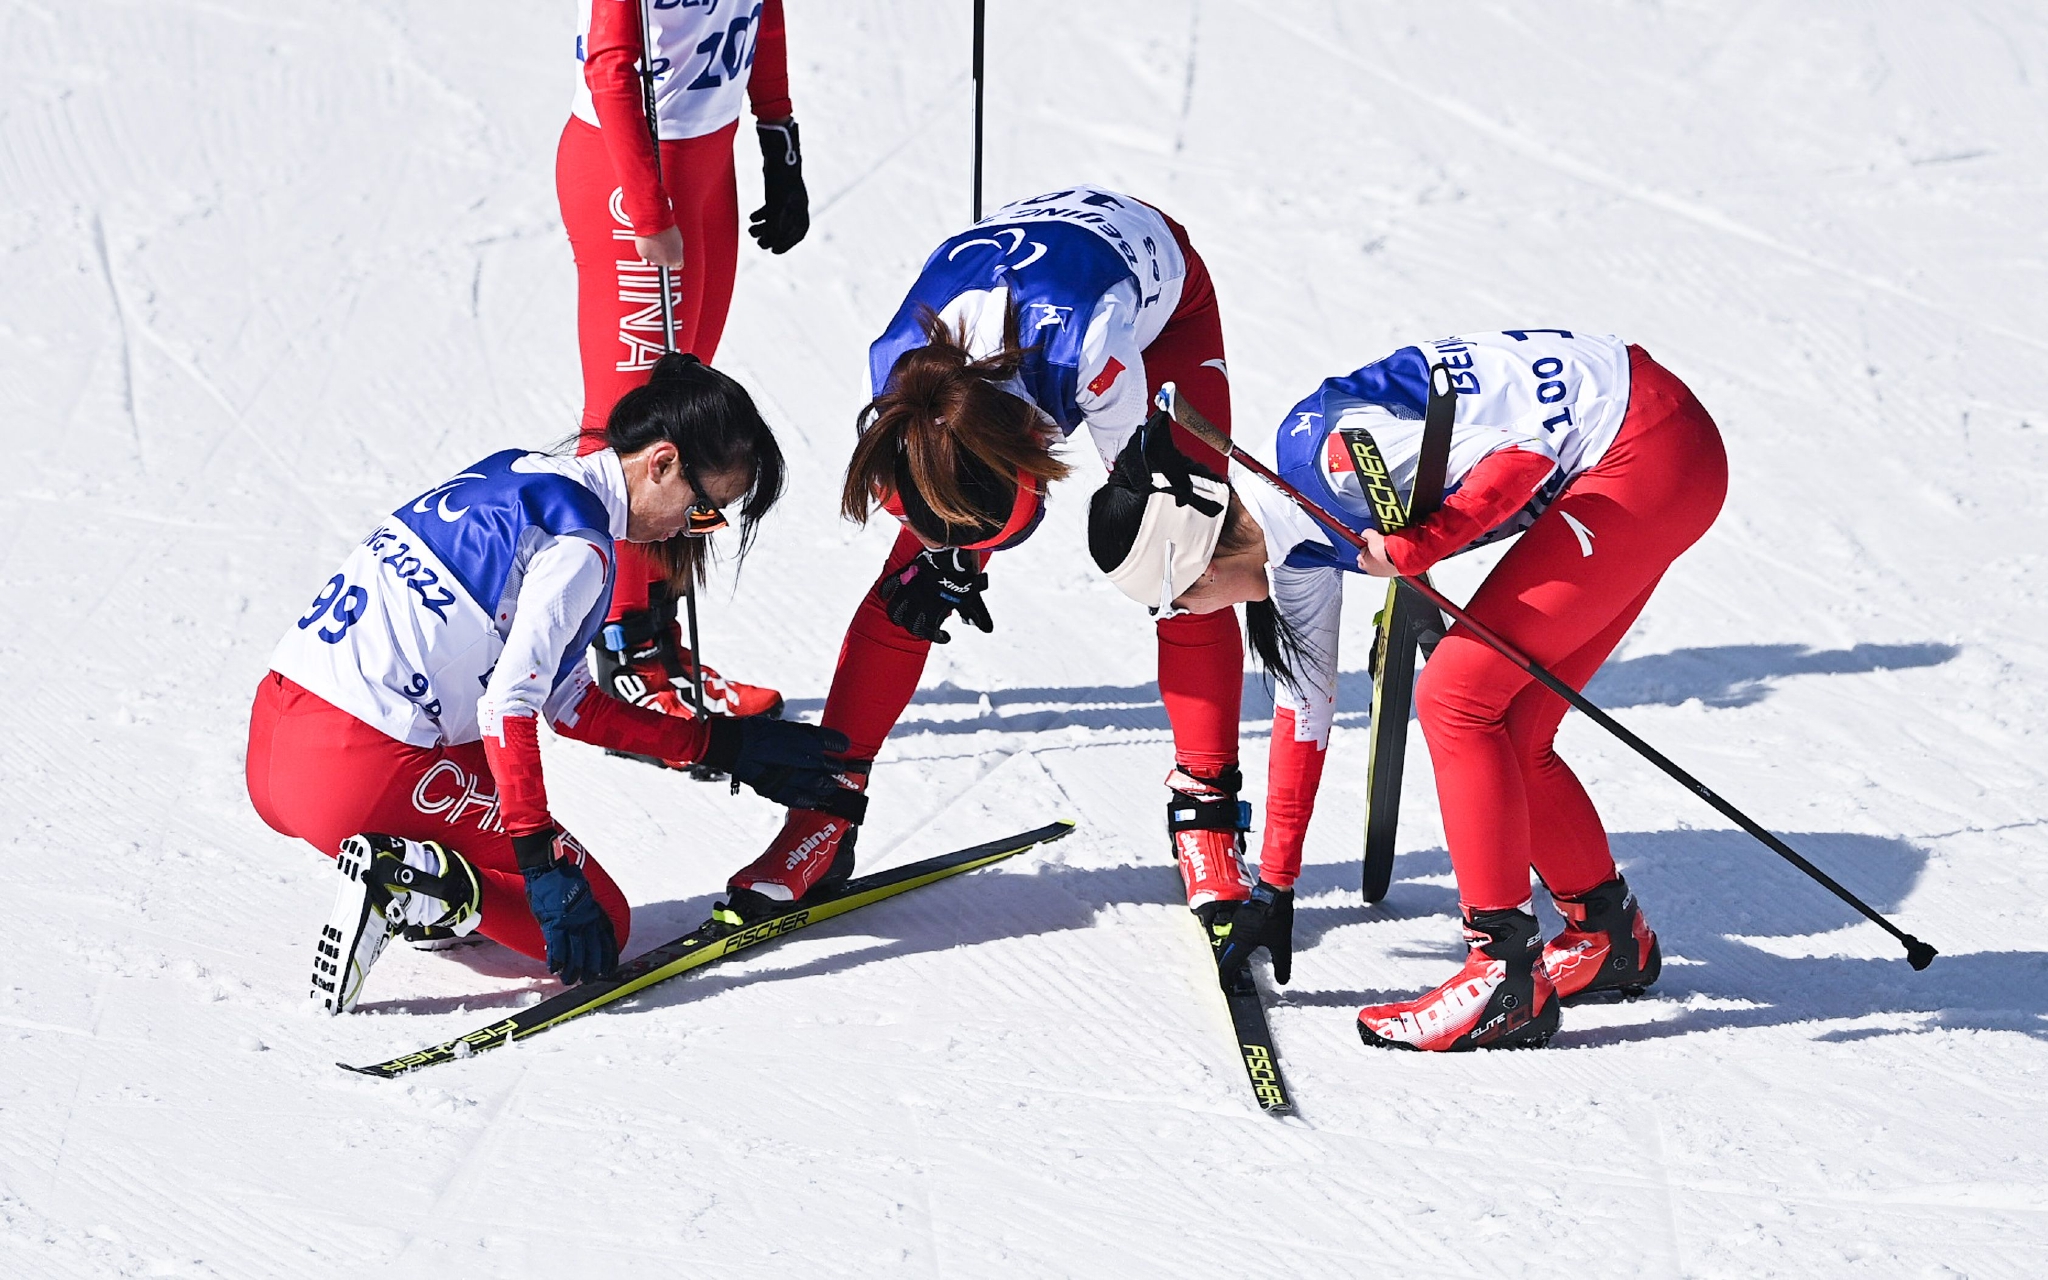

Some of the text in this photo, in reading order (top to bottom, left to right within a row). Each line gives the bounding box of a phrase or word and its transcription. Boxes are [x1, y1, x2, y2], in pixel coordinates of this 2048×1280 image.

[1010, 207, 1138, 265] BEIJING
[1142, 235, 1162, 309] 103
[1531, 356, 1573, 434] 100
[298, 573, 368, 645] 99
[383, 543, 457, 626] 2022
[785, 822, 838, 871] alpina
[1180, 832, 1207, 882] alpina
[723, 911, 810, 954] FISCHER
[1376, 960, 1507, 1041] alpina
[1470, 1012, 1506, 1040] ELITE
[1243, 1044, 1284, 1105] FISCHER
